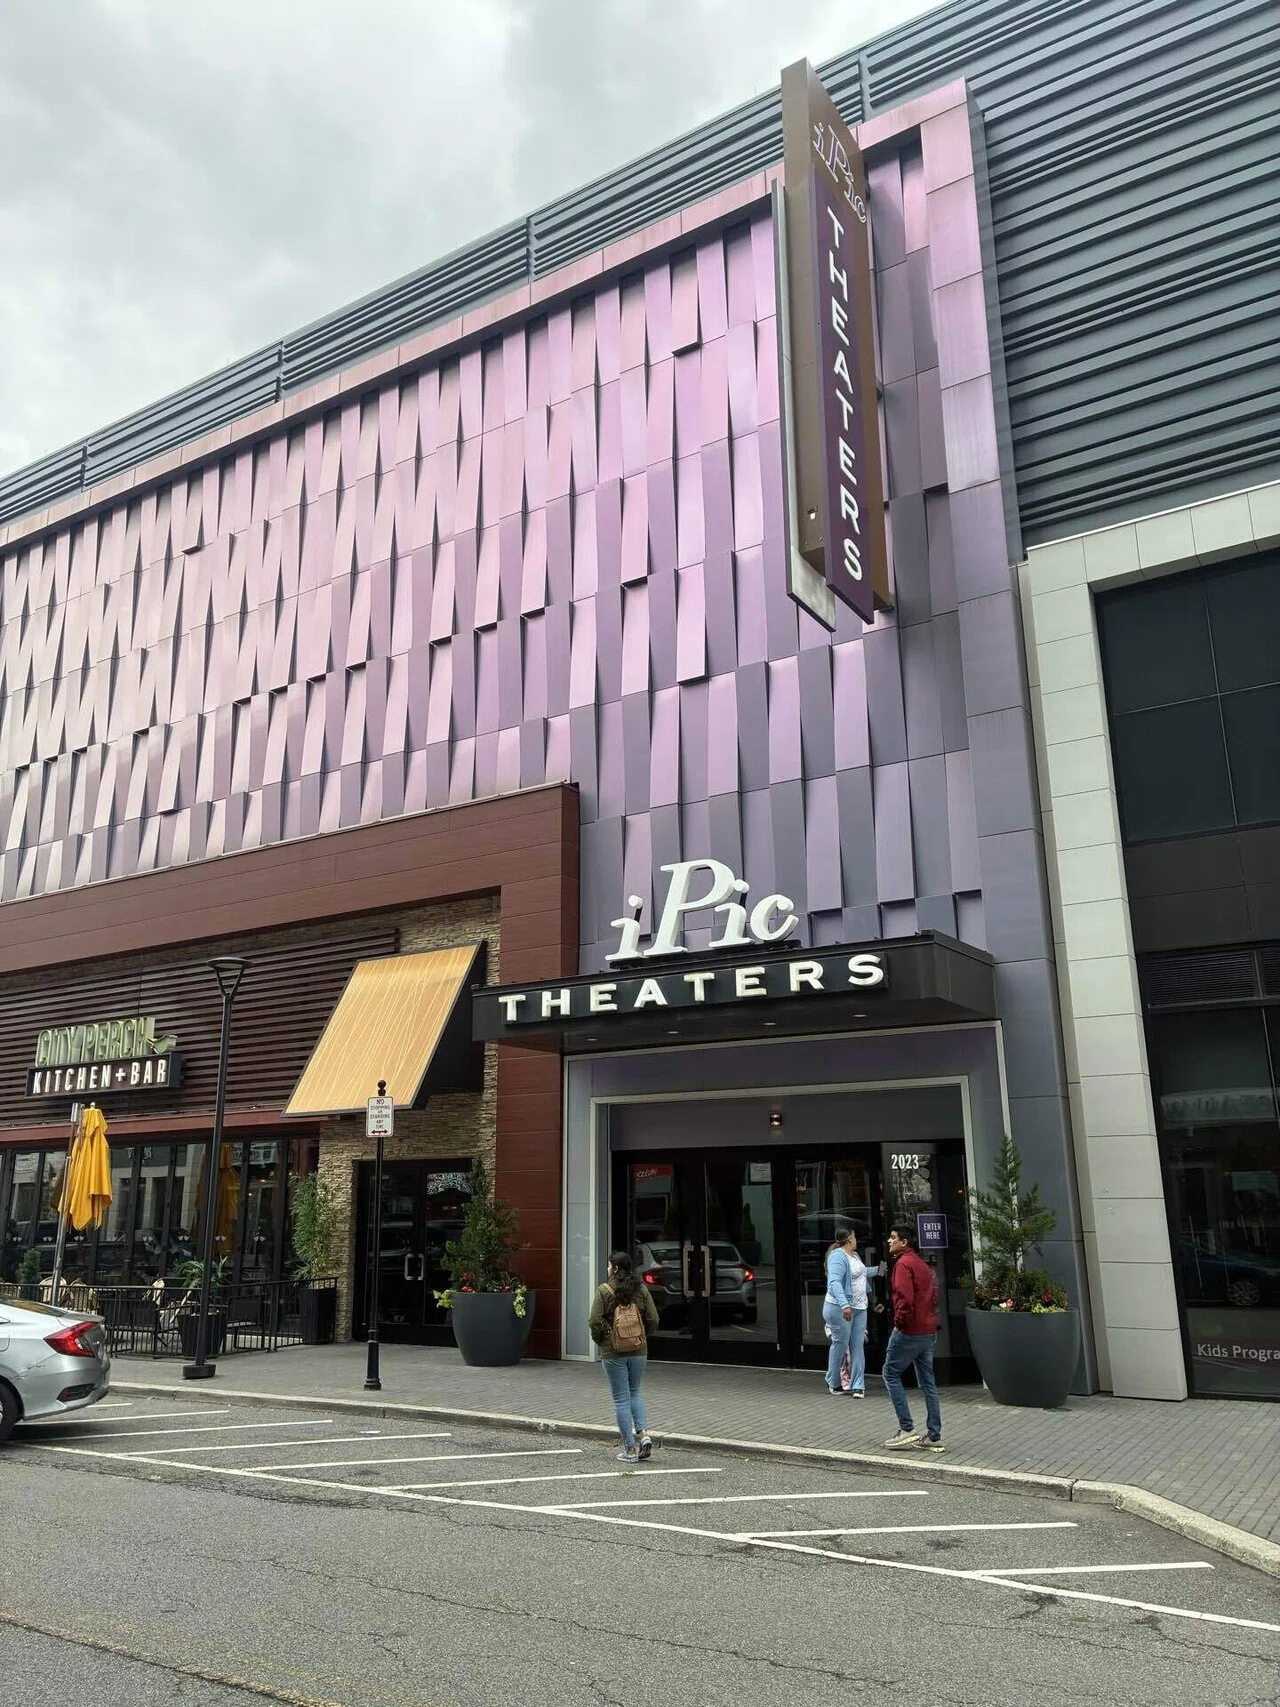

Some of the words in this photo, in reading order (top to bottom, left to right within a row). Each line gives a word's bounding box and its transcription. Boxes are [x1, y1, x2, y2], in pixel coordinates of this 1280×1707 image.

[812, 122, 867, 223] iPic
[827, 205, 863, 581] THEATERS
[605, 858, 800, 962] iPic
[498, 953, 885, 1022] THEATERS
[35, 1025, 81, 1067] CITY
[81, 1017, 155, 1062] PERCH
[33, 1064, 112, 1094] KITCHEN
[130, 1059, 167, 1085] BAR
[891, 1154, 919, 1170] 2023
[923, 1222, 942, 1231] ENTER
[925, 1231, 941, 1240] HERE
[1197, 1343, 1229, 1358] Kids
